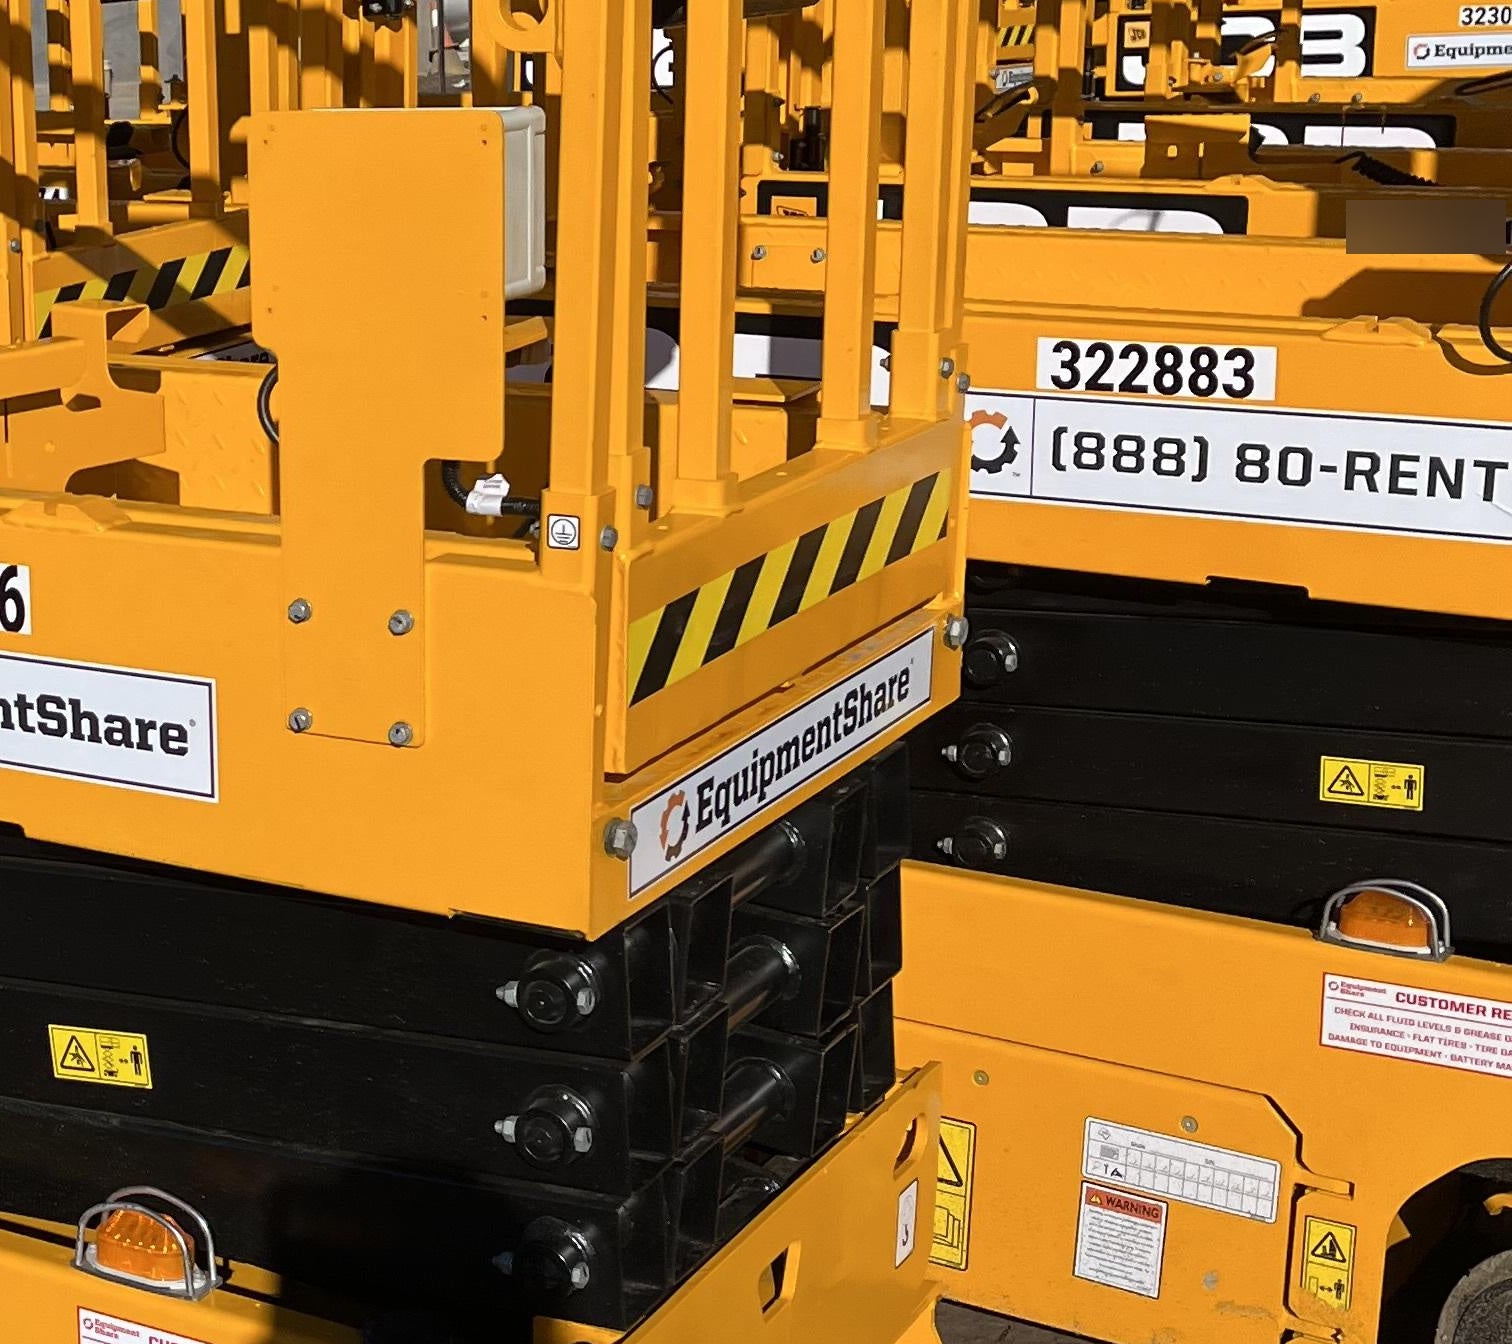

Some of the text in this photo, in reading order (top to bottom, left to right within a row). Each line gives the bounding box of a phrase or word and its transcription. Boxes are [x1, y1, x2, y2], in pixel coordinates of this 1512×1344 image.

[1050, 340, 1255, 399] 322883
[1052, 425, 1509, 502] (888) 80-RENT
[695, 666, 911, 835] EquipmentShare
[1395, 991, 1487, 1017] CUSTOMER
[1334, 1006, 1365, 1019] CHECK
[1367, 1012, 1384, 1022] ALL
[1386, 1015, 1415, 1027] FLUID
[1417, 1019, 1452, 1033] LEVELS
[1463, 1028, 1502, 1042] GREASE
[1349, 1022, 1405, 1040] INSURANCE
[1412, 1033, 1437, 1044] FLAT
[1439, 1036, 1467, 1050] TIRES
[1475, 1043, 1498, 1055] TIRE
[1328, 1032, 1368, 1047] DAMAGE
[1370, 1040, 1383, 1049] TO
[1384, 1043, 1442, 1059] EQUIPMENT
[1450, 1053, 1494, 1068] BATTERY
[1105, 1195, 1160, 1219] WARNING
